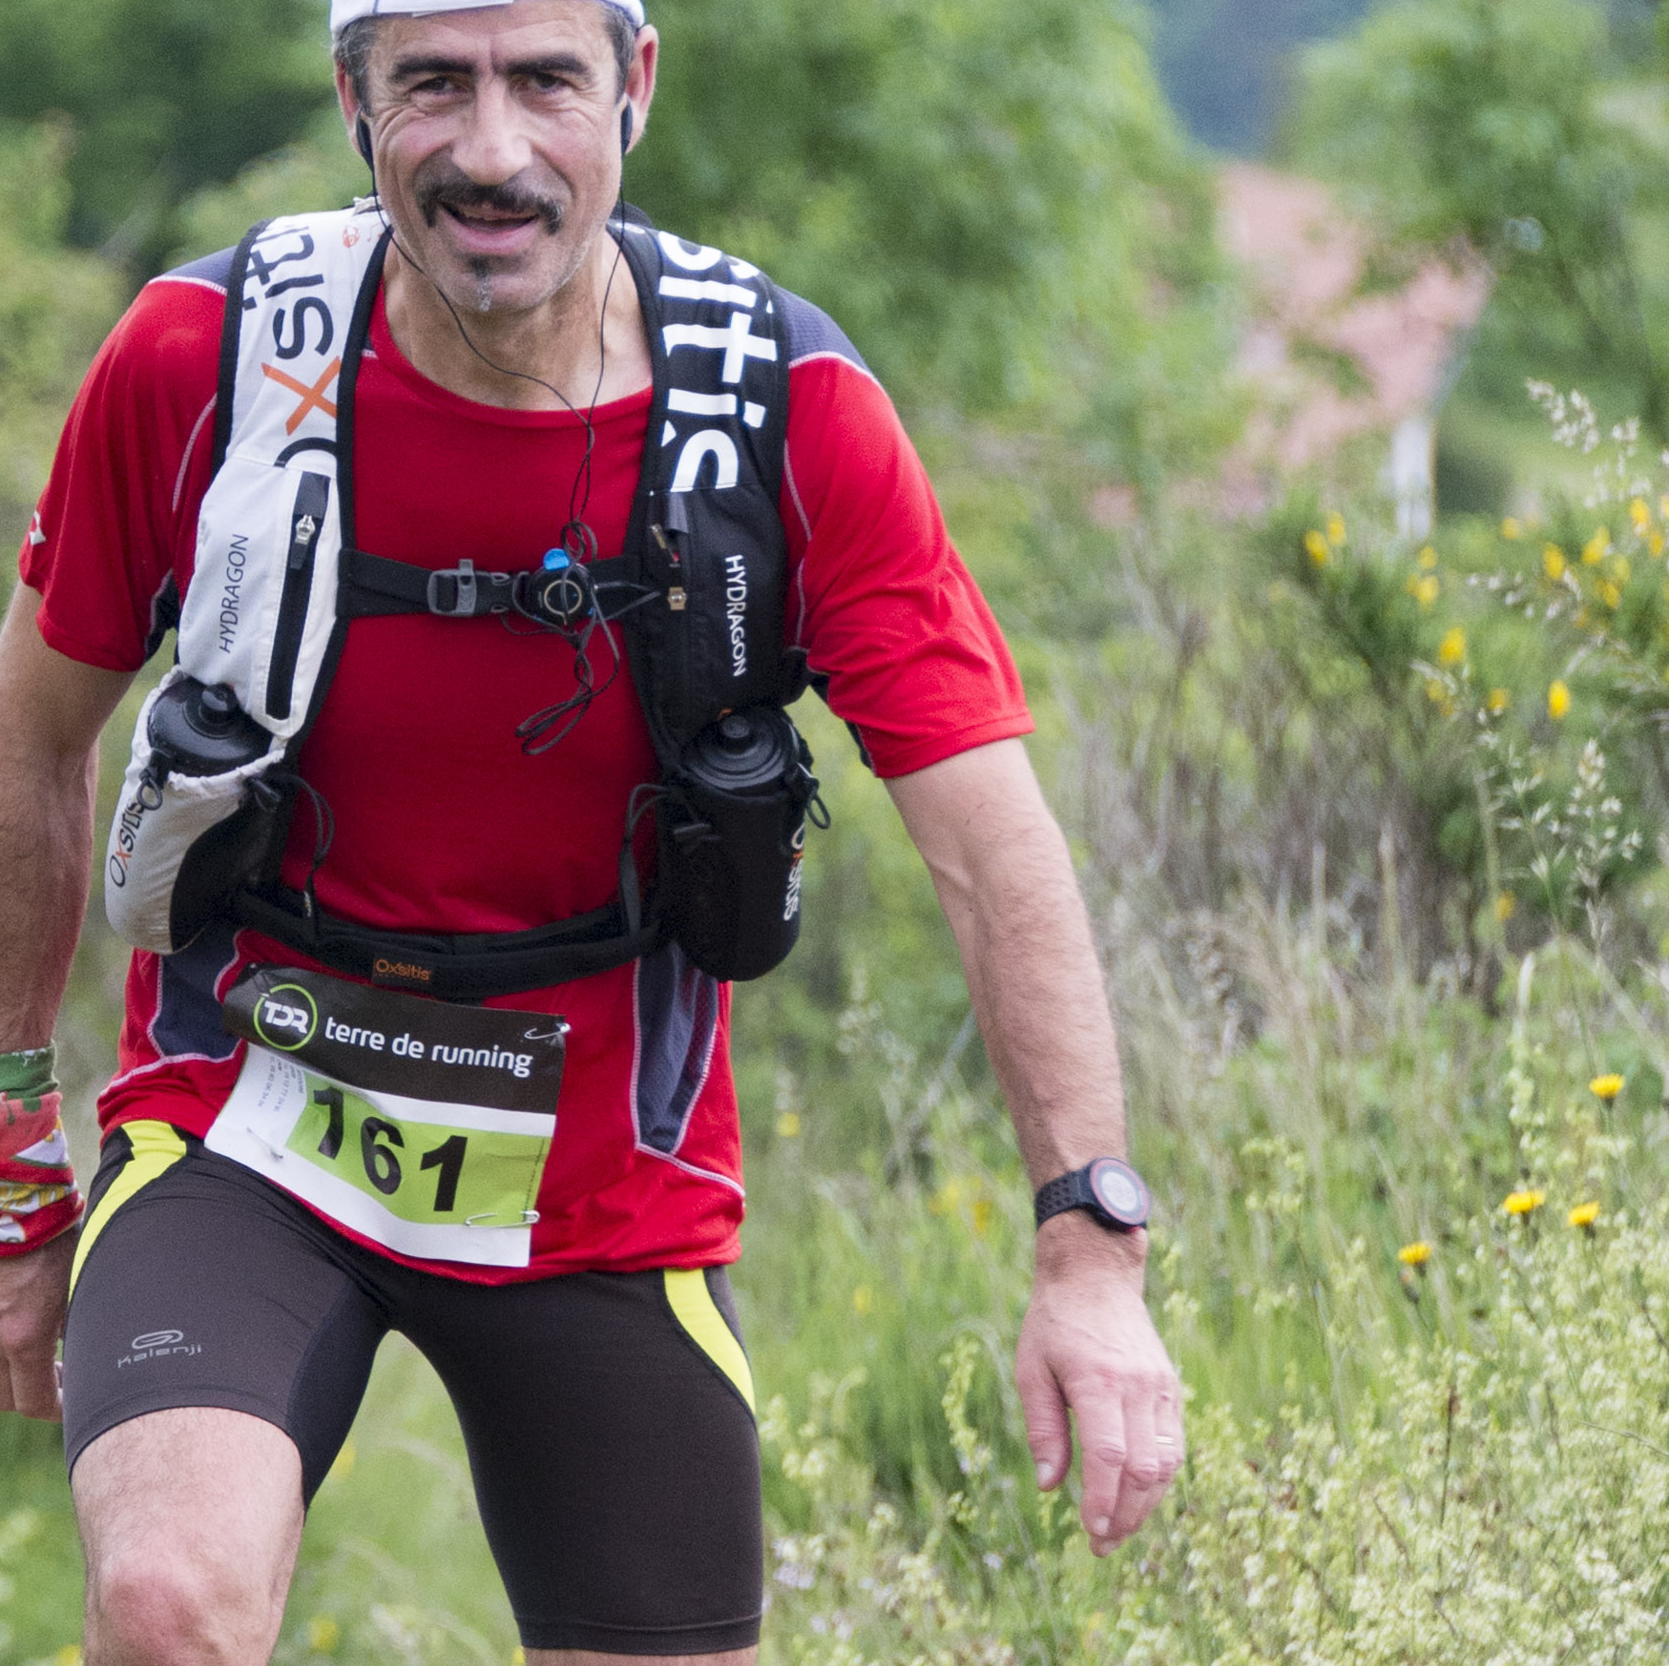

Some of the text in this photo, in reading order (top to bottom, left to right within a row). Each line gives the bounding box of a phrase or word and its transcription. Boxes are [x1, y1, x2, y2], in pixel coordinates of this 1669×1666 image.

[219, 533, 250, 654] HYDRAGON
[725, 554, 747, 677] HYDRAGON
[264, 1000, 309, 1034] TDR
[324, 1016, 534, 1078] terre de running
[313, 1086, 468, 1212] 161
